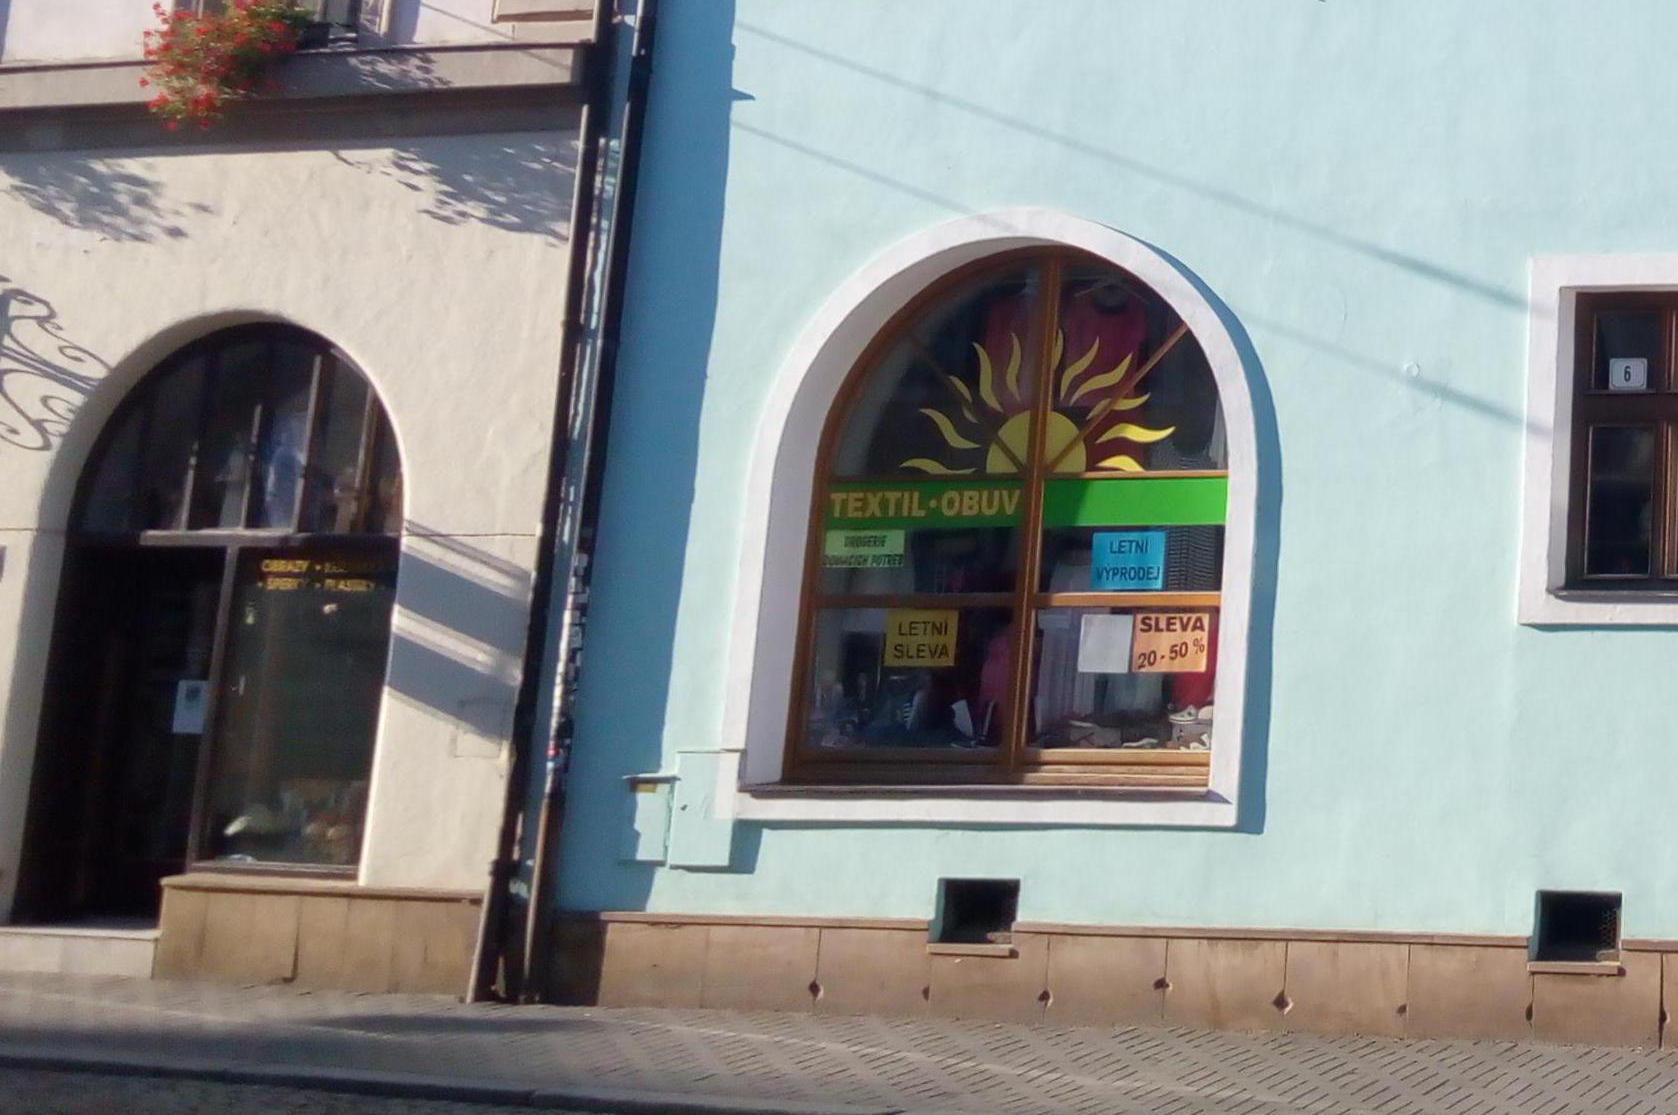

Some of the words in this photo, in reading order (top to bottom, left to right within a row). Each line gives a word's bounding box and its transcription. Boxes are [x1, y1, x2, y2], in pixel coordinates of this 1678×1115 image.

[1623, 365, 1631, 382] 6
[830, 491, 926, 518] TEXTIL
[941, 489, 1021, 517] OBUV
[1139, 616, 1205, 633] SLEVA
[893, 644, 949, 659] SLEVA
[1137, 650, 1157, 669] 20
[1169, 641, 1188, 661] 50
